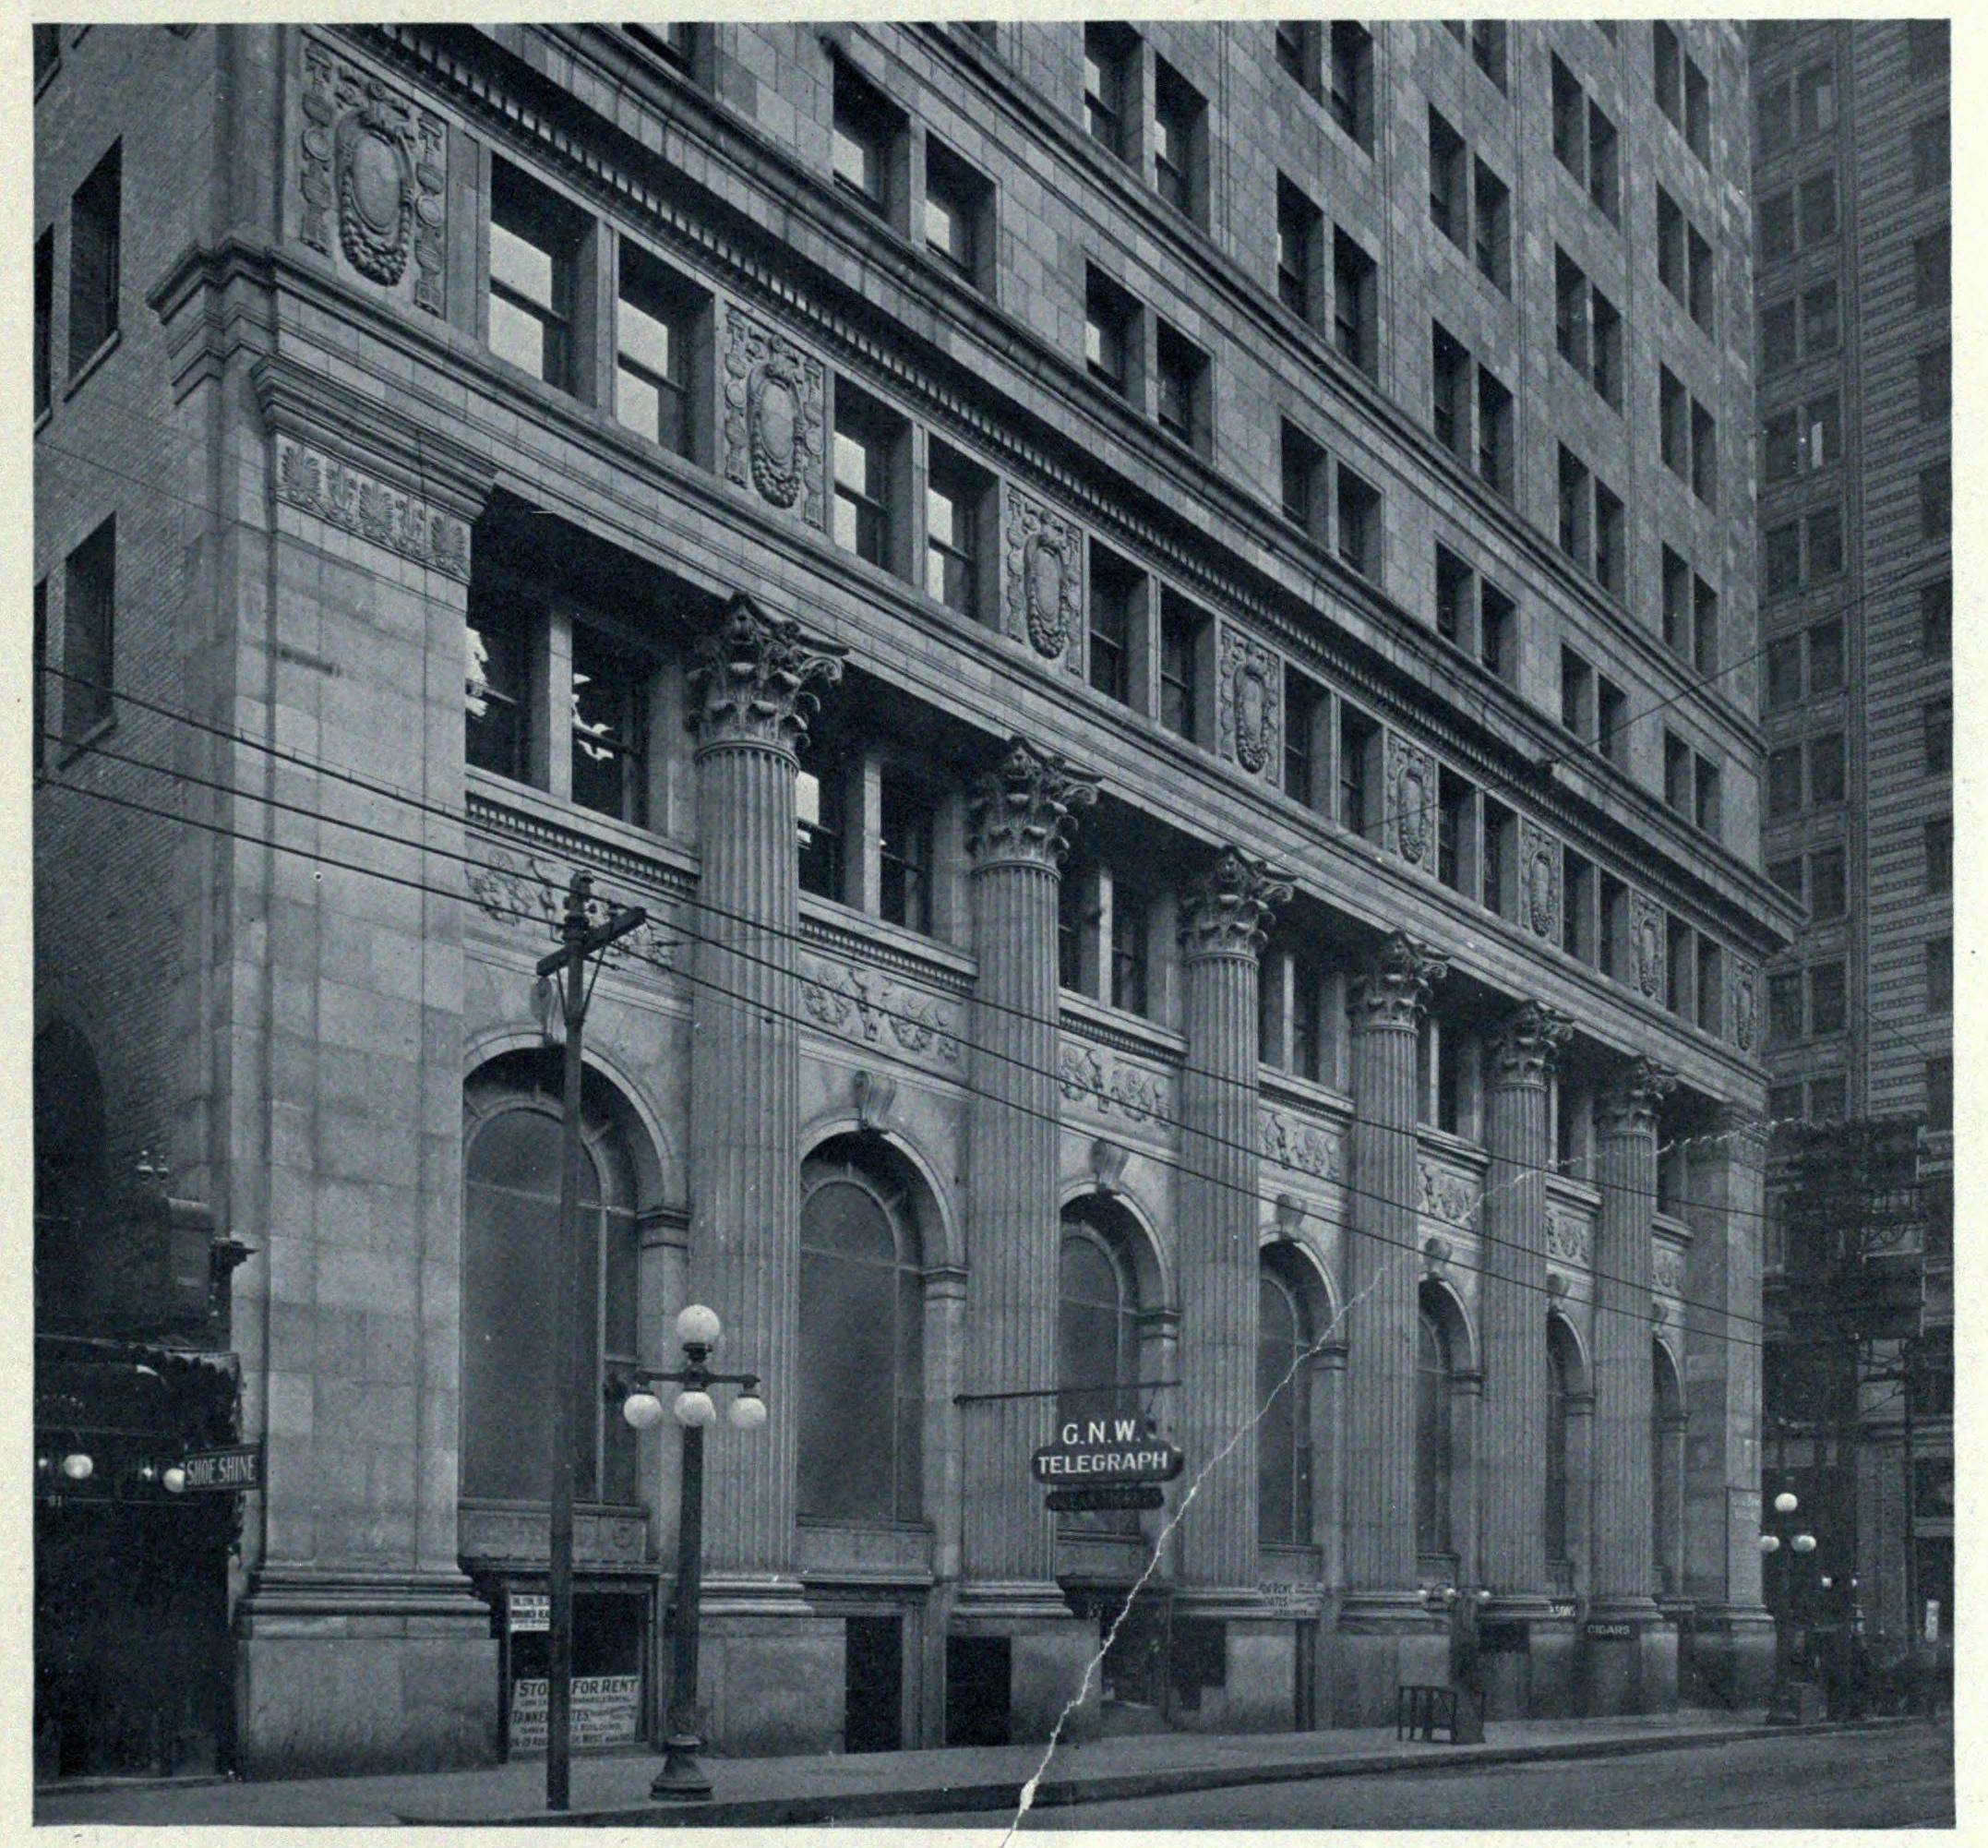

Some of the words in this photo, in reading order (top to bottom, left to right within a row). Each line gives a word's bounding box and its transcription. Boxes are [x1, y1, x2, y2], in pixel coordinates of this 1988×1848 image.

[1062, 1419, 1142, 1446] G.N.W.
[186, 1458, 216, 1486] SHOE
[219, 1454, 256, 1483] SHINE
[1037, 1450, 1168, 1475] TELEGRAPH
[1587, 1624, 1631, 1635] CIGARS
[520, 1682, 546, 1698] STO
[571, 1680, 599, 1695] FOR
[602, 1678, 637, 1694] RENT
